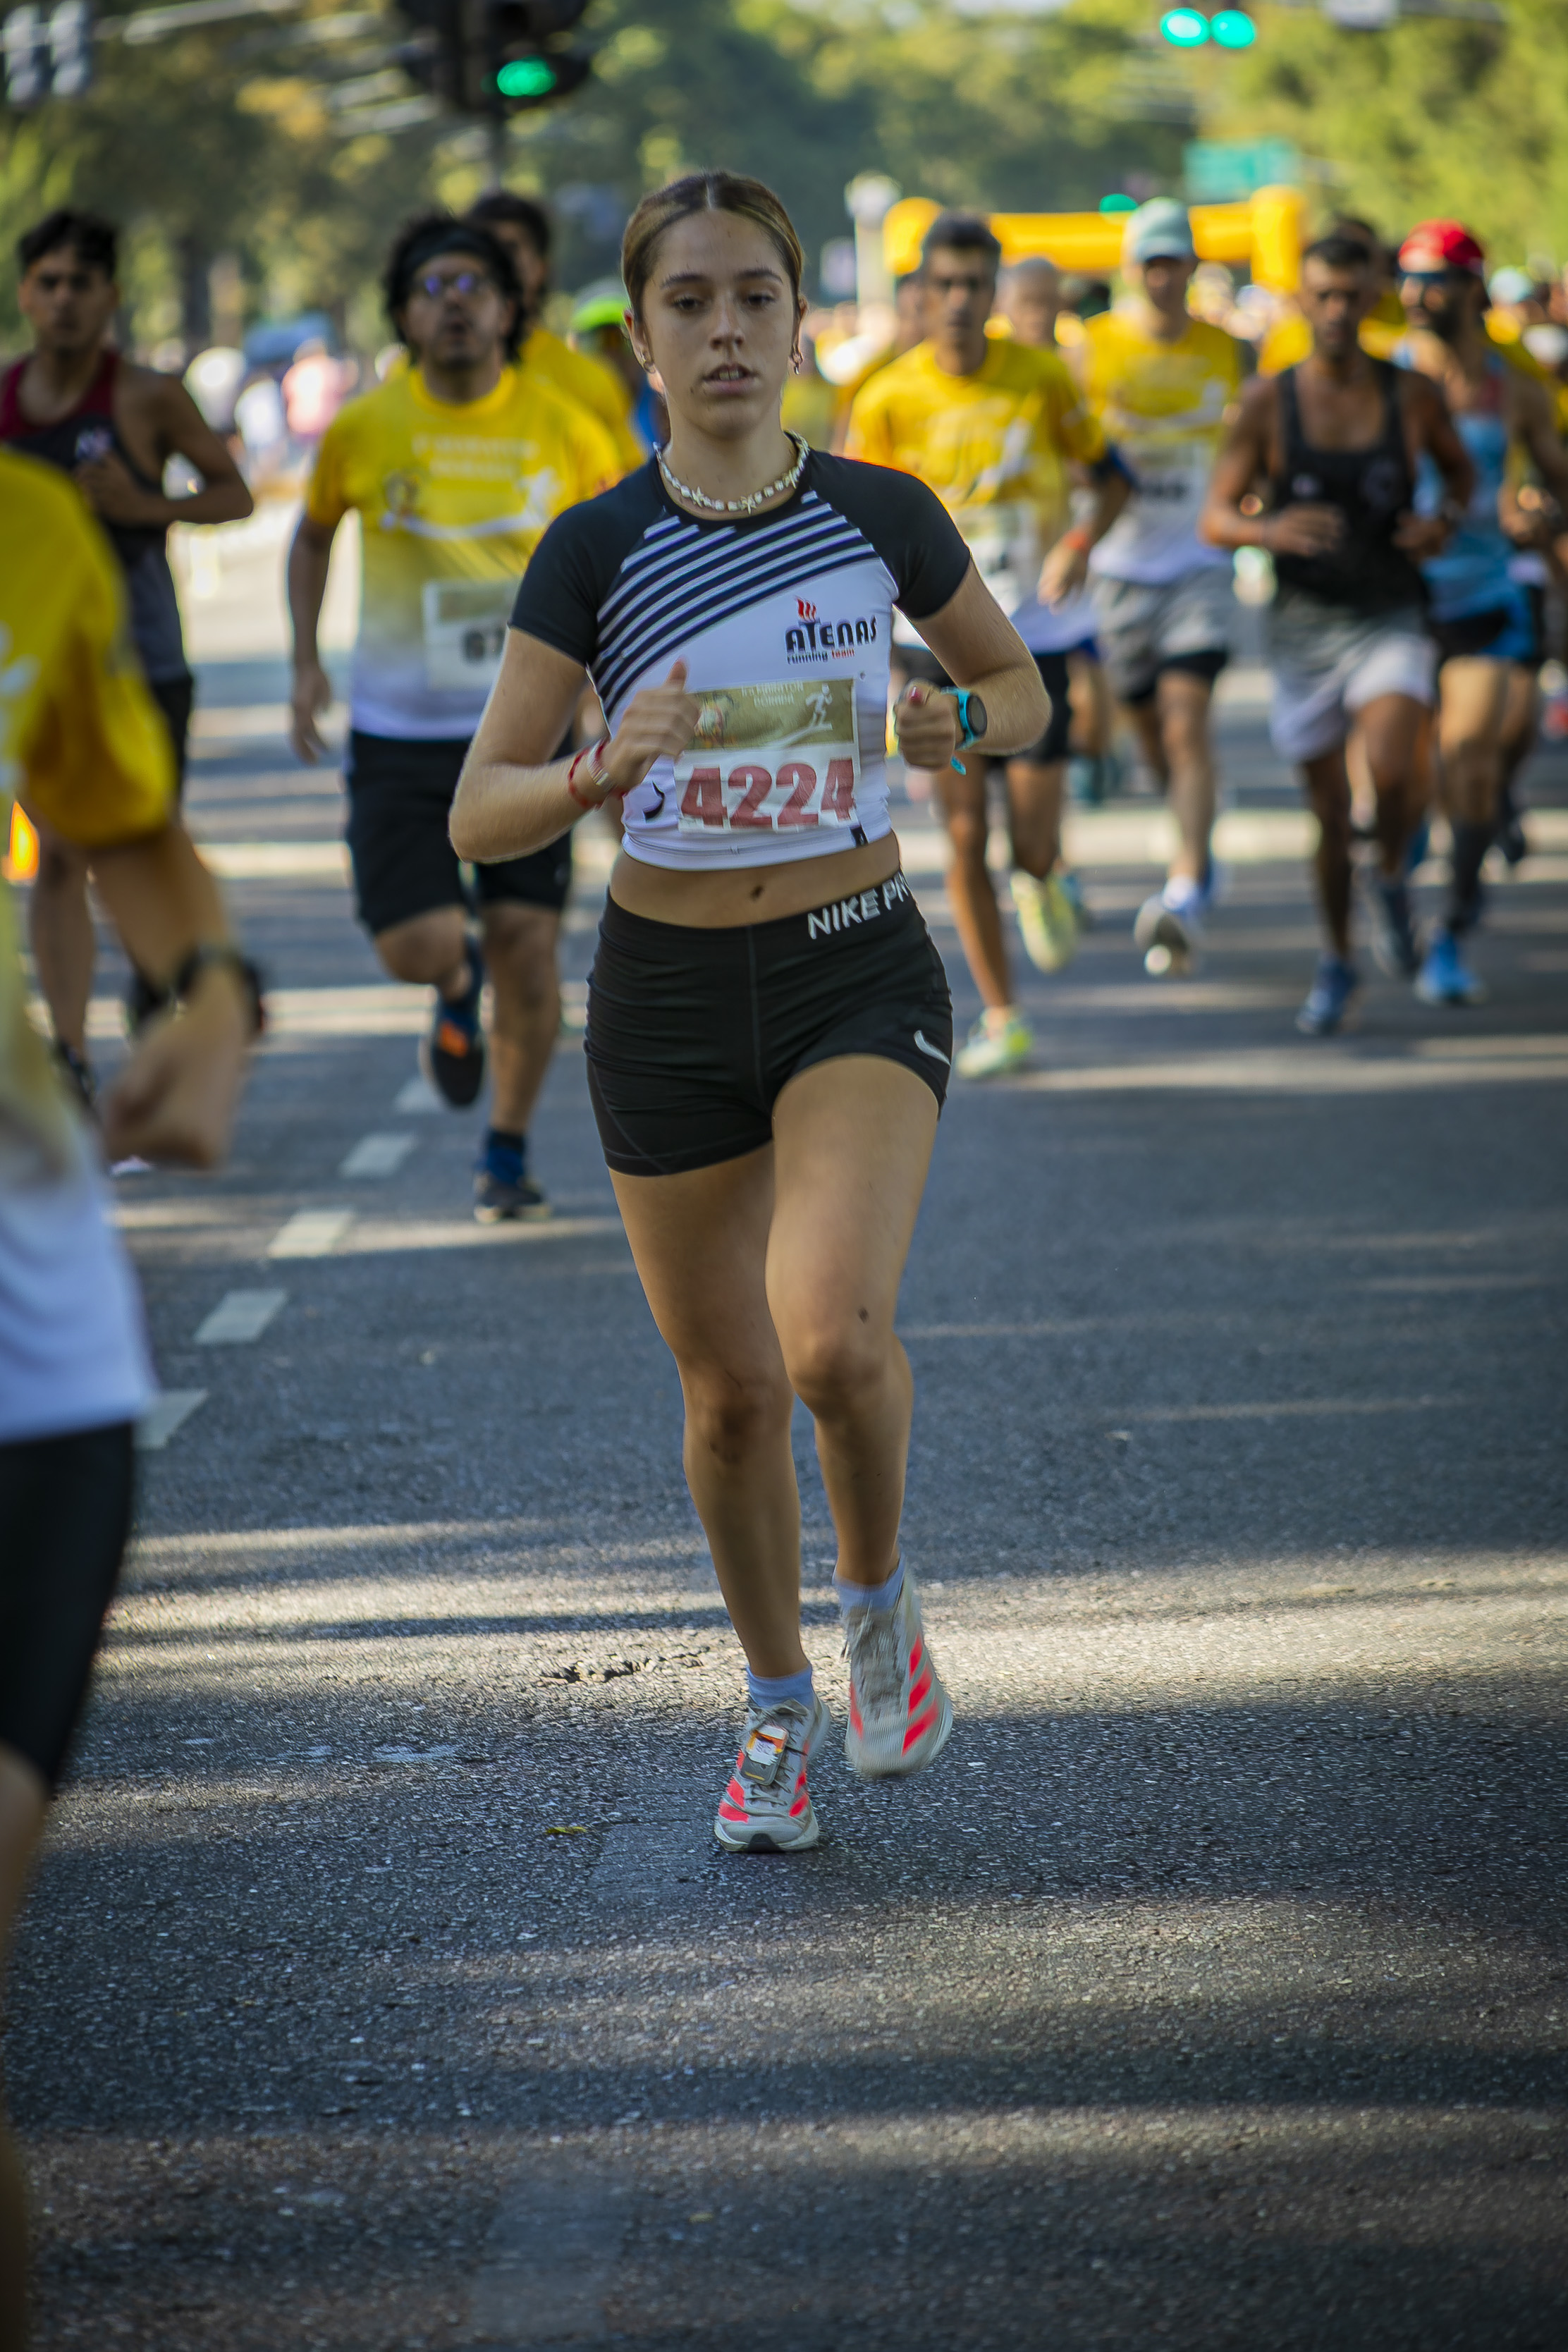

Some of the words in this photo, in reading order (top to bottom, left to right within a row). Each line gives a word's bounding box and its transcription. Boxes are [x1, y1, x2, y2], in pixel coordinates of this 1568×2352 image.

[787, 651, 828, 664] running
[831, 648, 855, 659] team
[681, 757, 856, 829] 4224
[807, 888, 881, 940] NIKE
